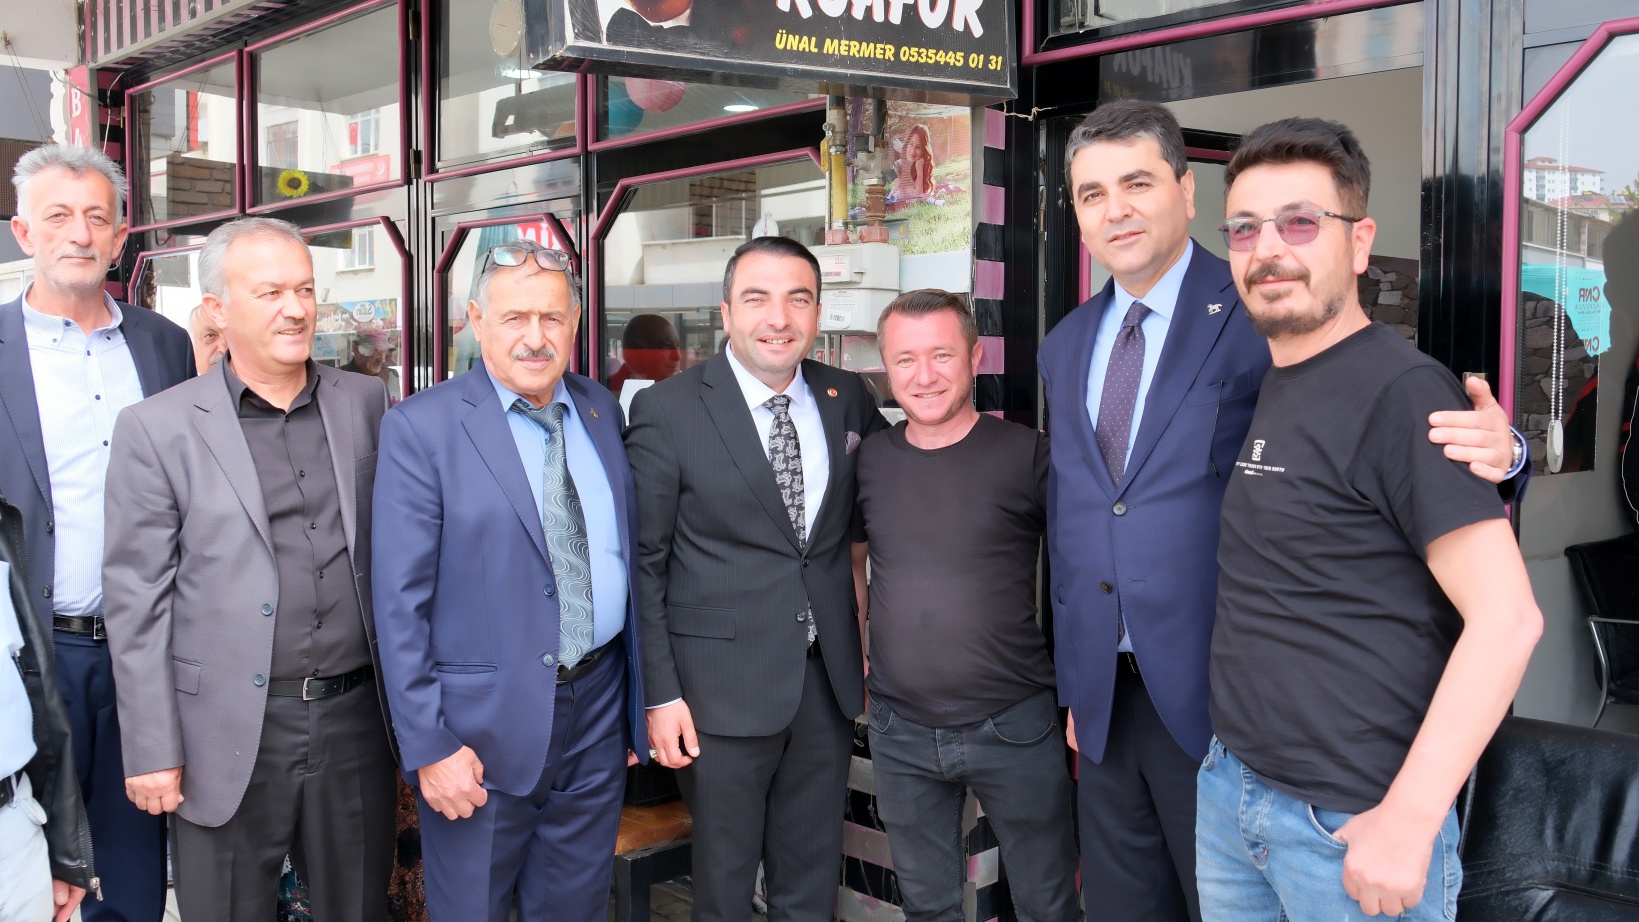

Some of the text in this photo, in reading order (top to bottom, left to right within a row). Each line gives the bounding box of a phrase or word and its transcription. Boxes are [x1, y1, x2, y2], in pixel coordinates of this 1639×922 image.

[775, 29, 1003, 71] ÜNAL MERMER 0535445 01 31
